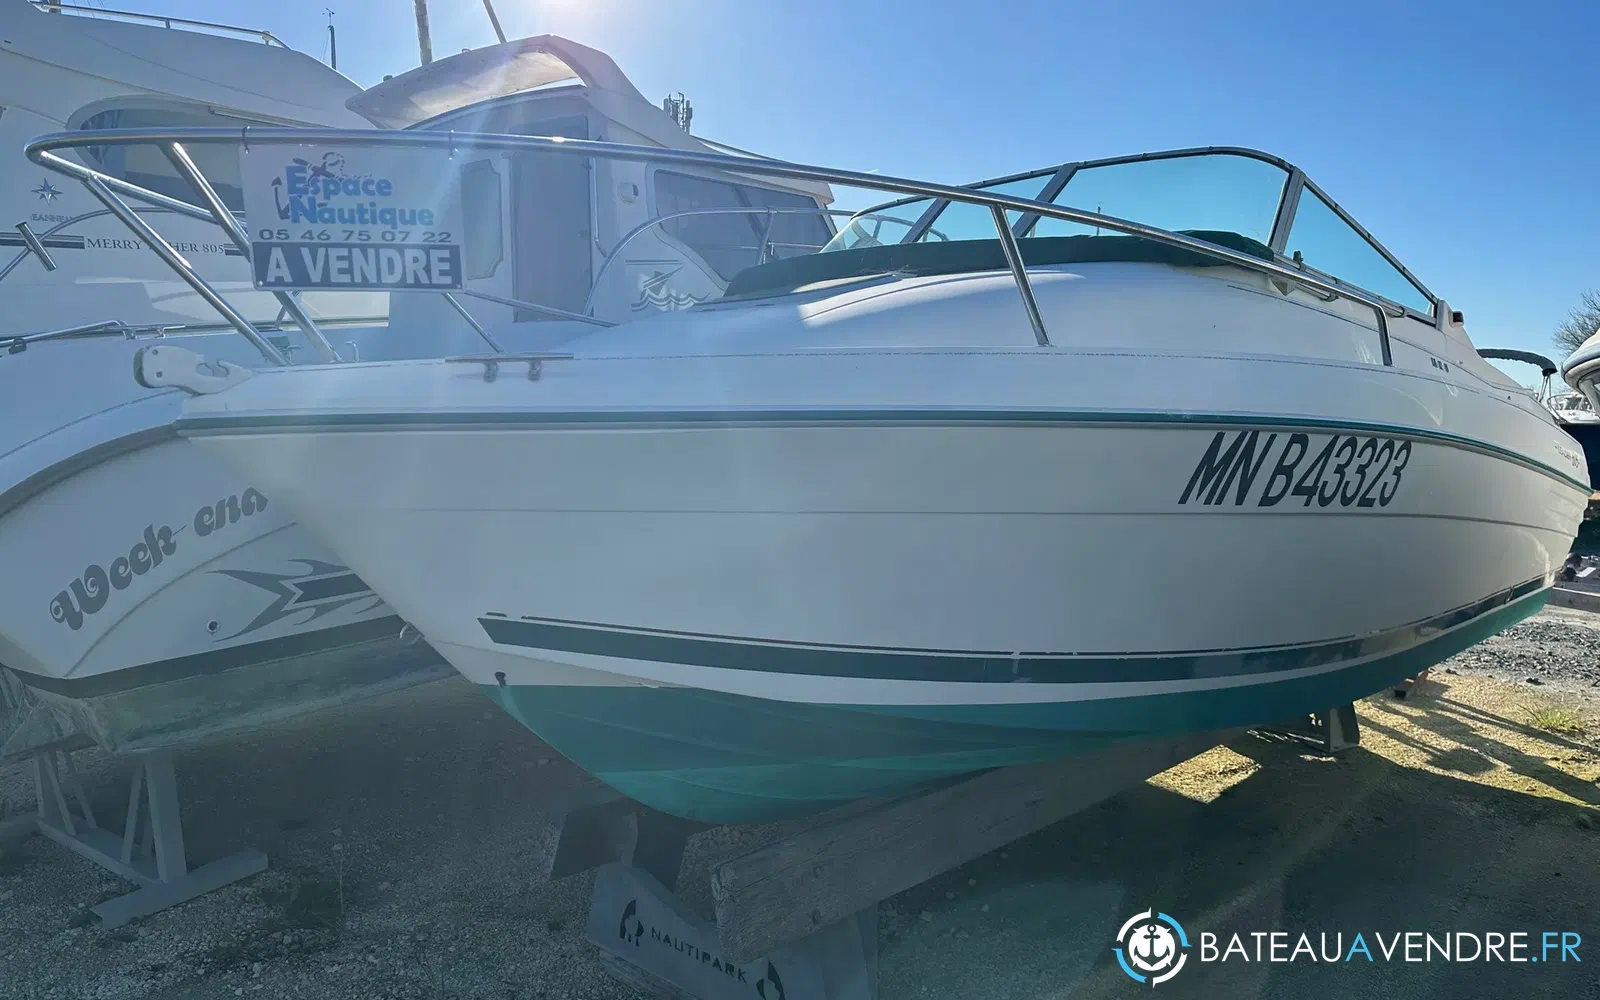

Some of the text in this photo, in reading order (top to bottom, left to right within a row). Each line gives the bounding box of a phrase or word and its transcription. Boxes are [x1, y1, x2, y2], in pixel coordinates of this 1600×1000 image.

[286, 165, 392, 200] Espace
[289, 196, 434, 229] Nautique
[87, 238, 142, 250] MERRY
[202, 243, 224, 253] 805
[259, 229, 452, 243] 05 46 75 07 22
[266, 247, 452, 284] A VENDRE
[1257, 433, 1412, 508] B43323
[651, 927, 748, 984] NAUTIPARK
